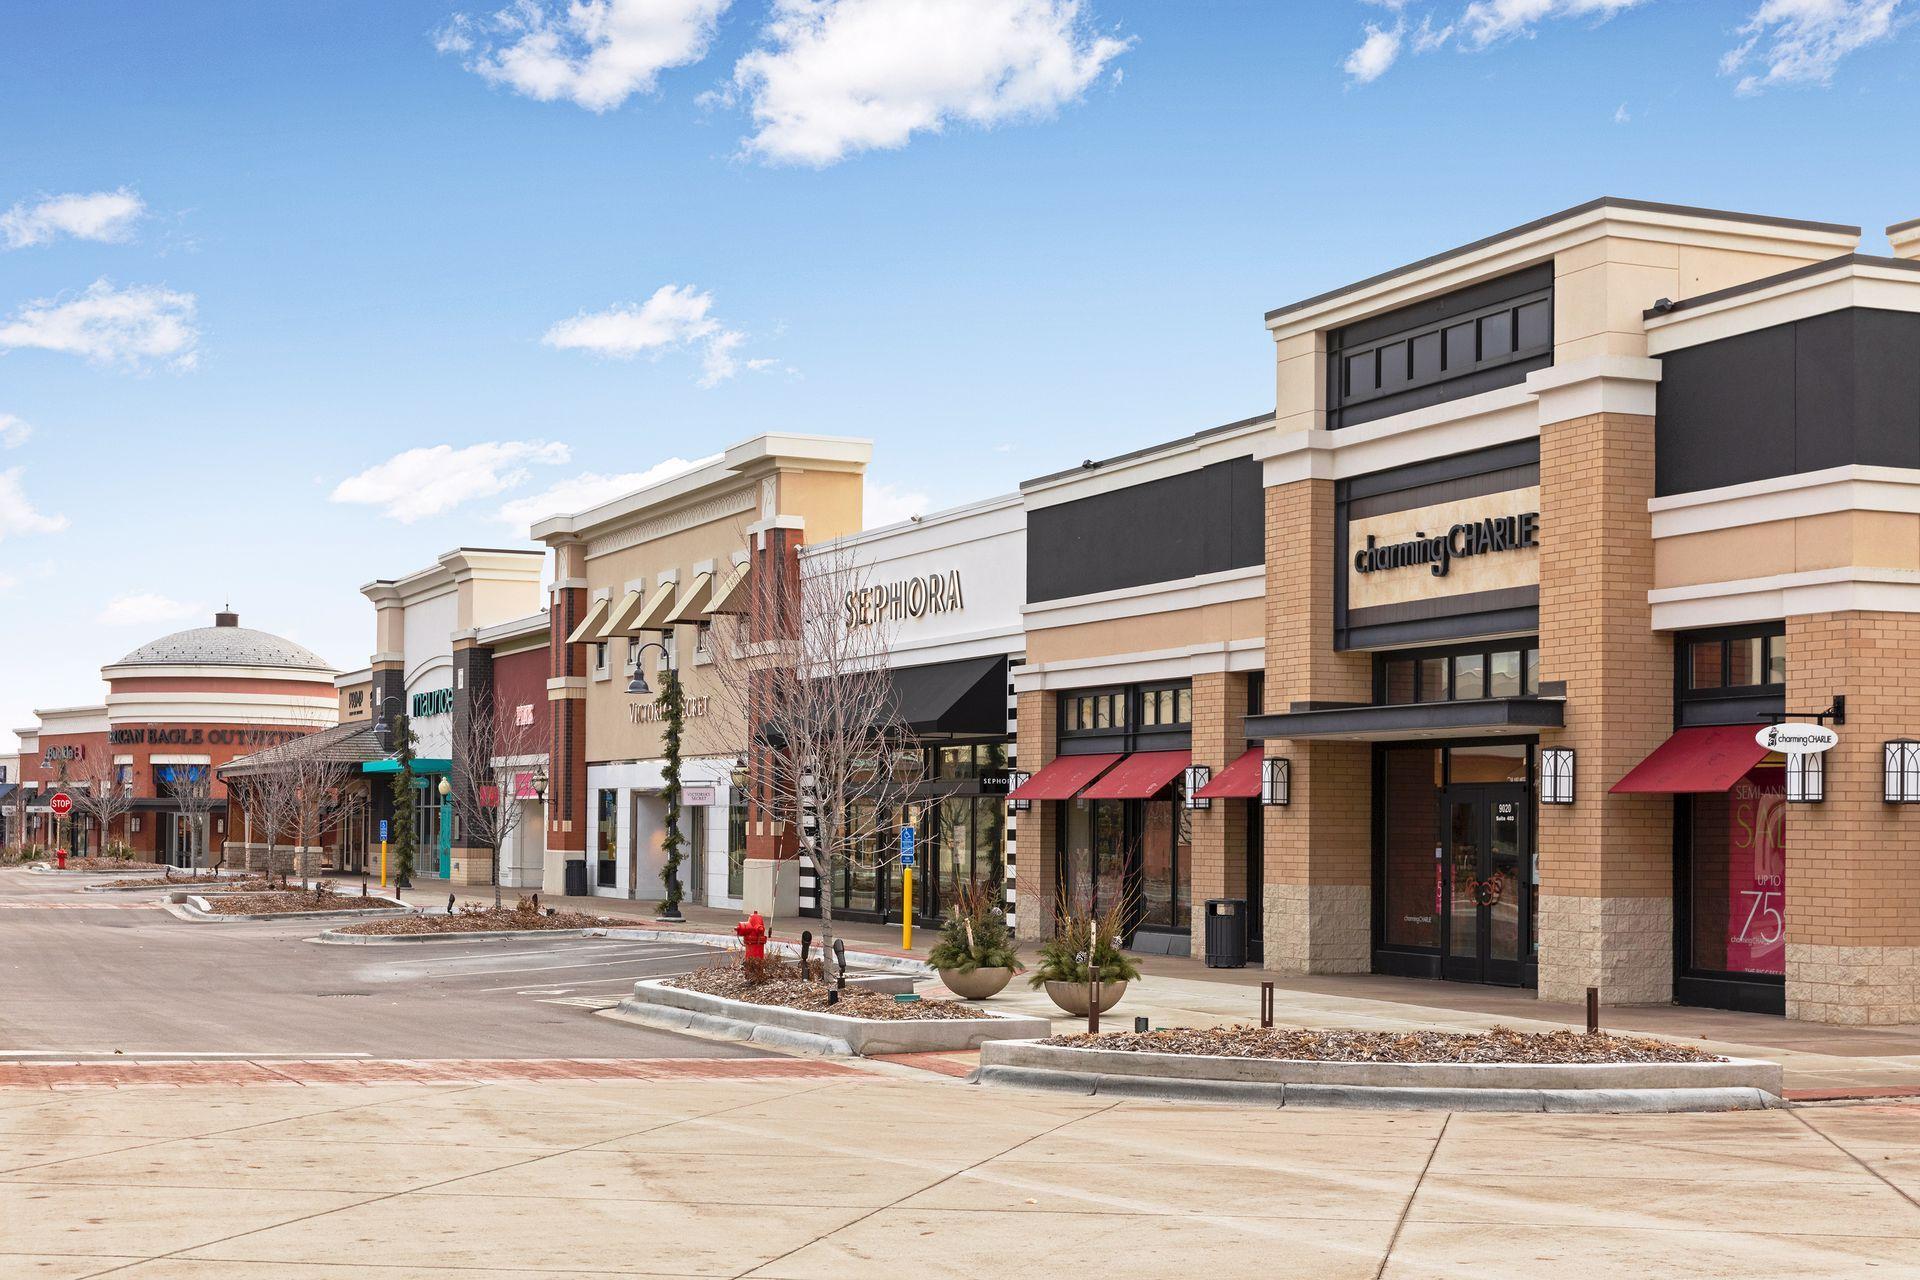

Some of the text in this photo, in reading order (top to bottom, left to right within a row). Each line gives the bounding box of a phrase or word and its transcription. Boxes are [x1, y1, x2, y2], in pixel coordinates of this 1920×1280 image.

[844, 569, 964, 629] SEPHORA
[680, 695, 710, 718] ECRET
[108, 729, 146, 745] RICAN
[147, 729, 204, 745] EAGLE
[51, 799, 71, 808] STOP
[1498, 803, 1512, 813] 9020
[1757, 874, 1781, 887] UP TO
[1740, 890, 1786, 943] 75
